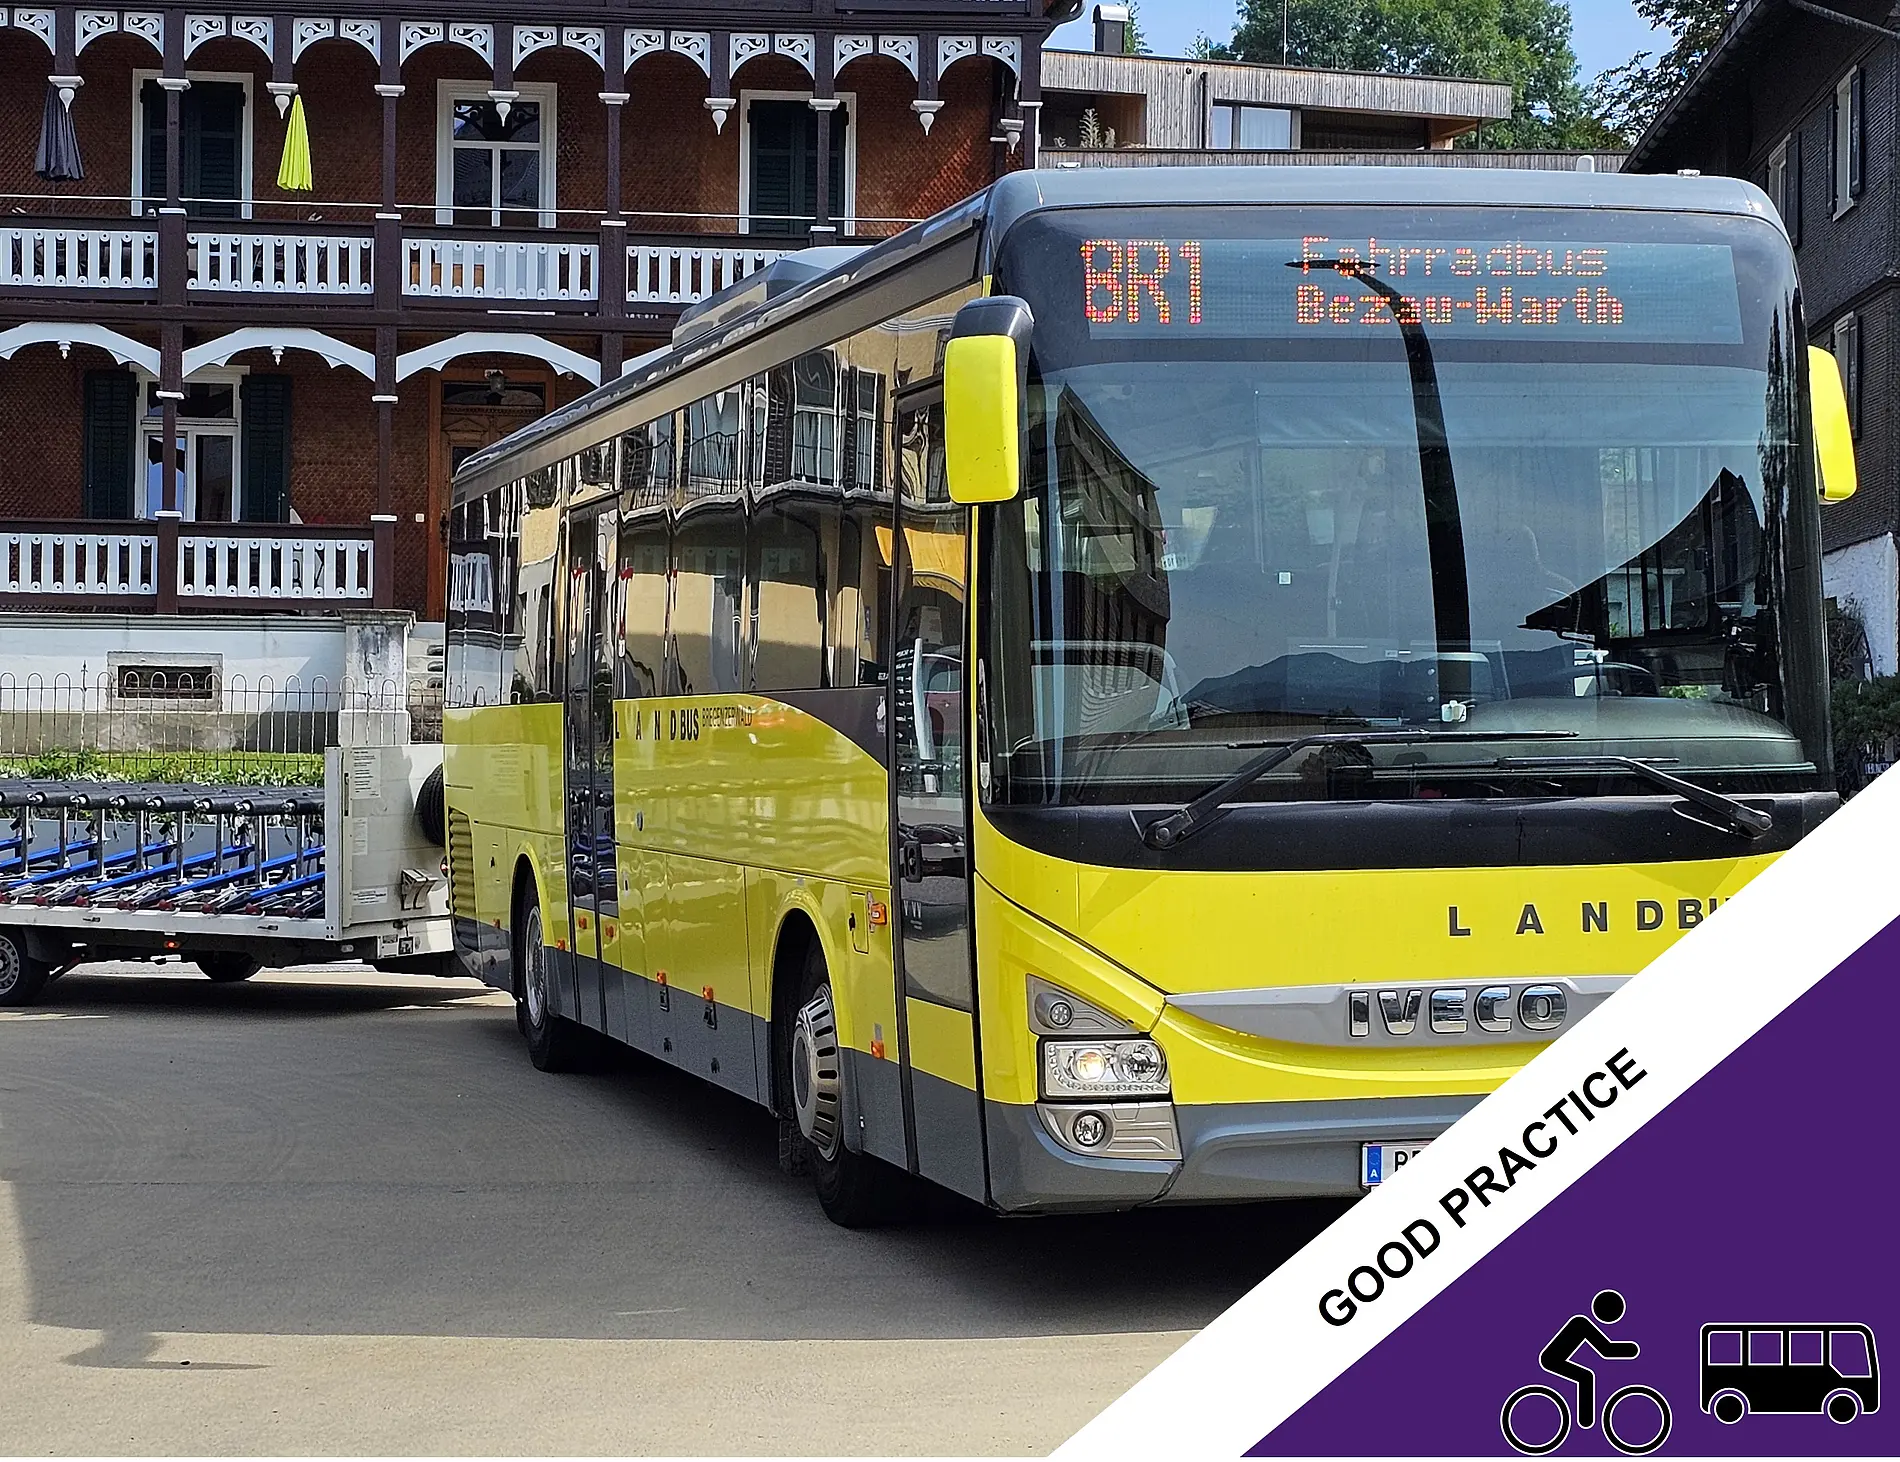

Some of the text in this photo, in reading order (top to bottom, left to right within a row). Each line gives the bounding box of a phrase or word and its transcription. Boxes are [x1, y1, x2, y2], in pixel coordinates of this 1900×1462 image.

[1302, 236, 1609, 276] Fahrradbus
[1079, 240, 1202, 324] BR1
[1296, 285, 1624, 325] Bezau-Warth
[1349, 983, 1568, 1037] IVECO
